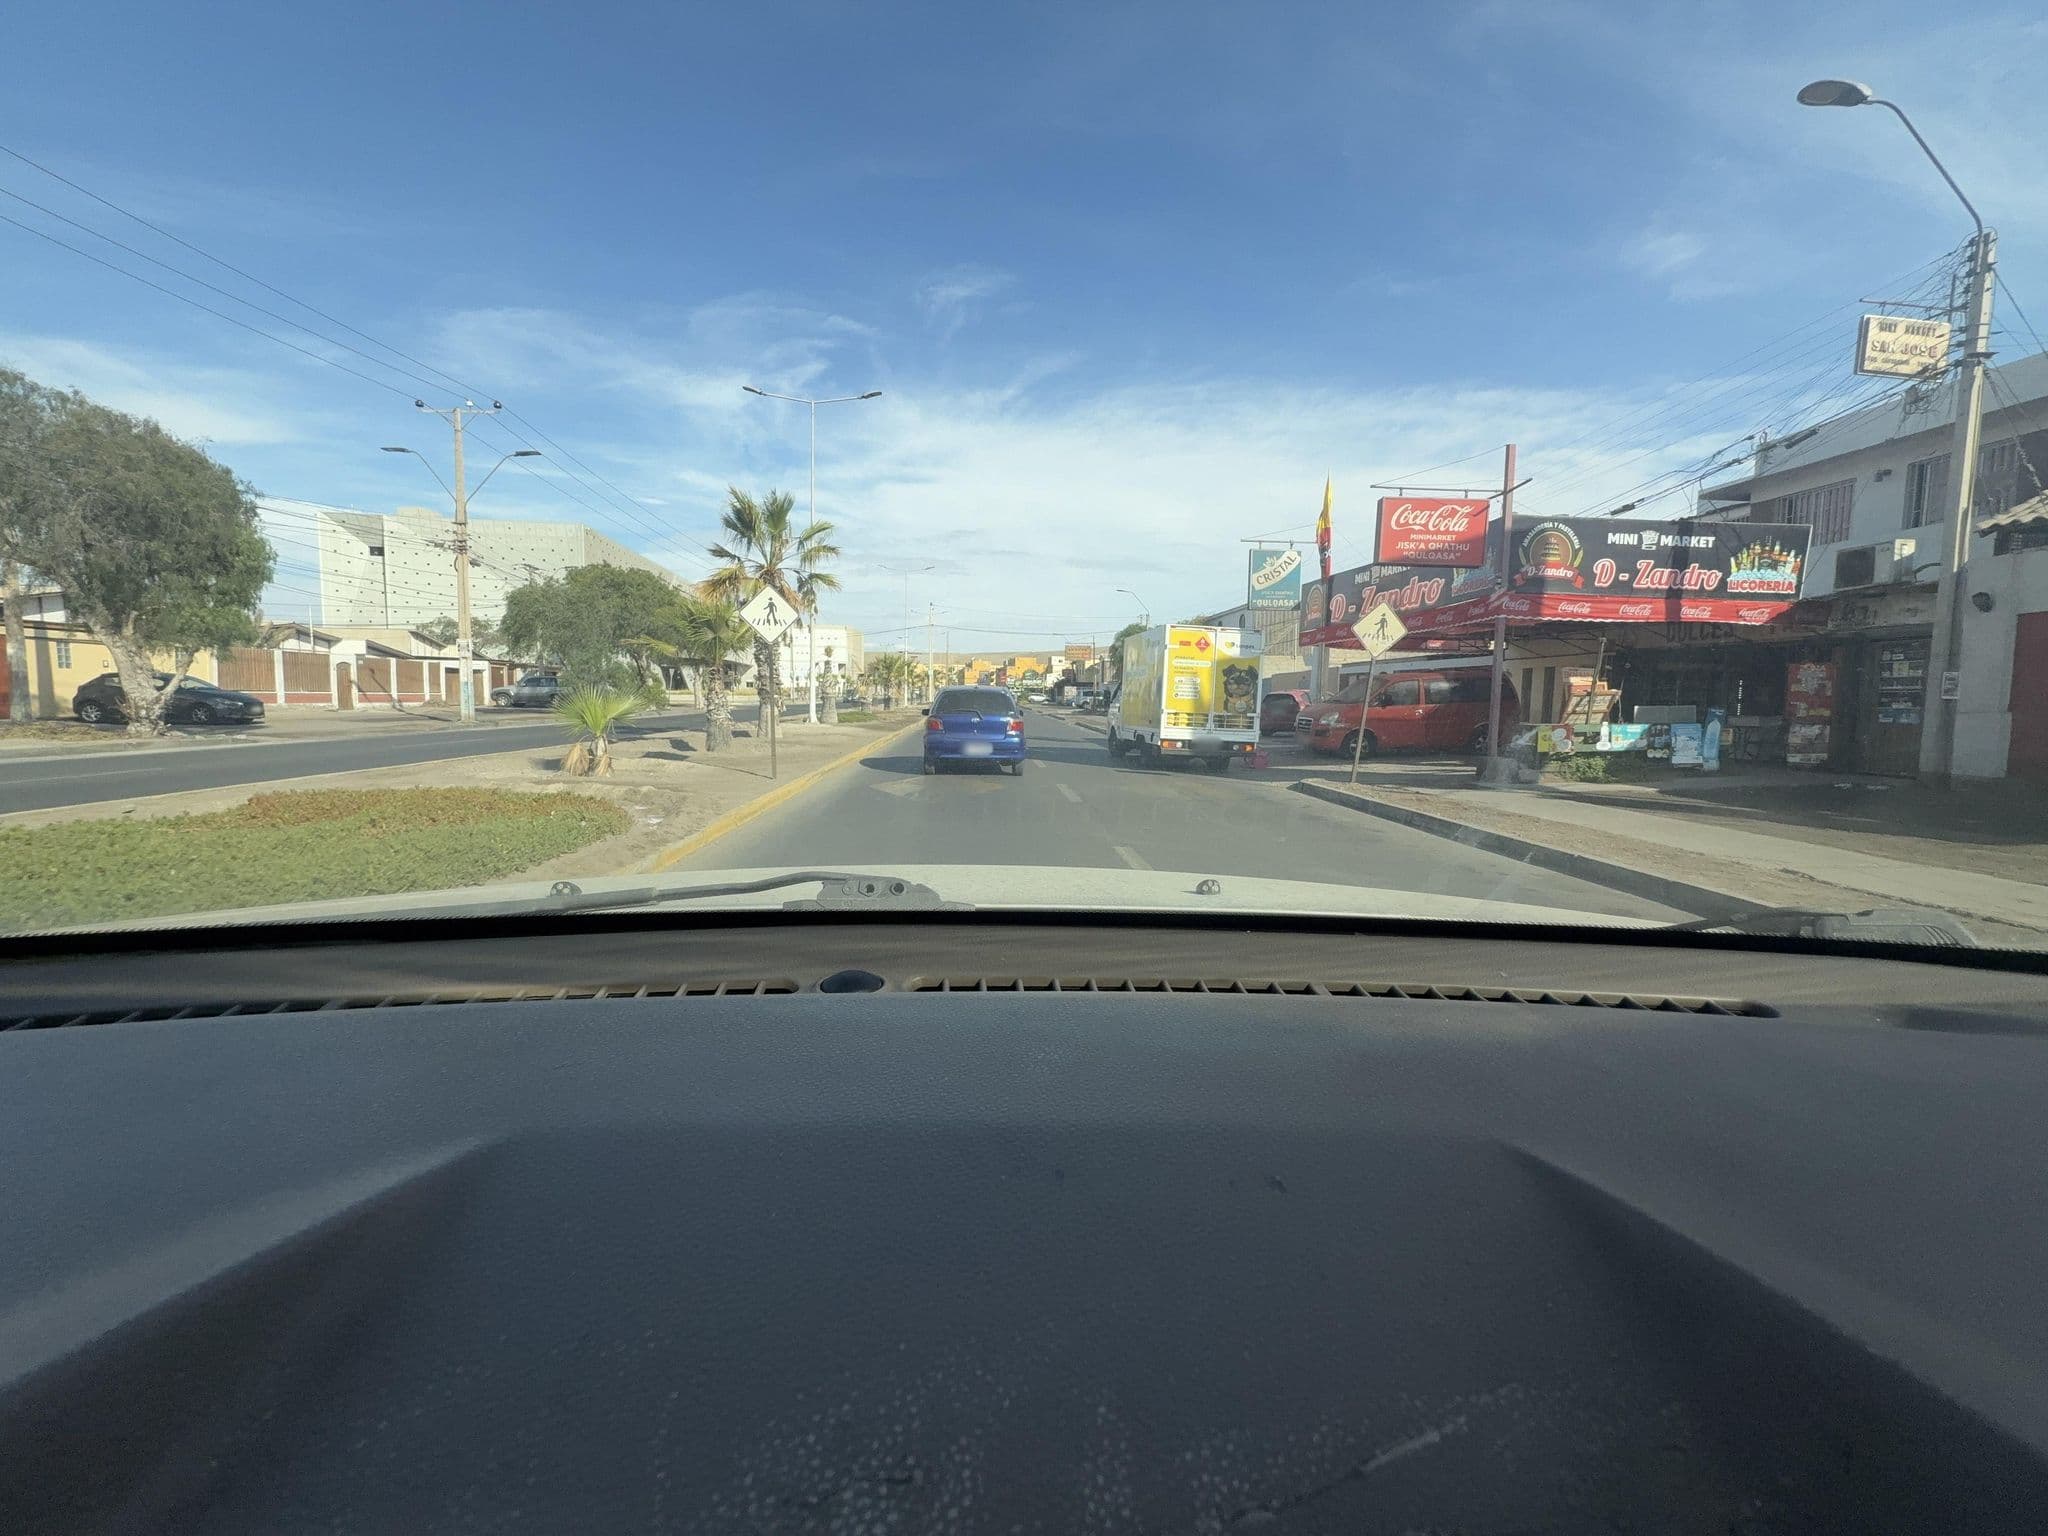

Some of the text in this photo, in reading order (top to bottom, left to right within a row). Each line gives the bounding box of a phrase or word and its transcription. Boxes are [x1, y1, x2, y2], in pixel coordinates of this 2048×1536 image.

[1871, 340, 1896, 354] SAN
[1391, 503, 1475, 531] Coca-Cola
[1607, 532, 1715, 548] MINI MARKET
[1256, 555, 1297, 586] CRISTAL
[1354, 571, 1370, 584] MINI
[1593, 558, 1616, 587] D
[1633, 560, 1722, 590] Zandro
